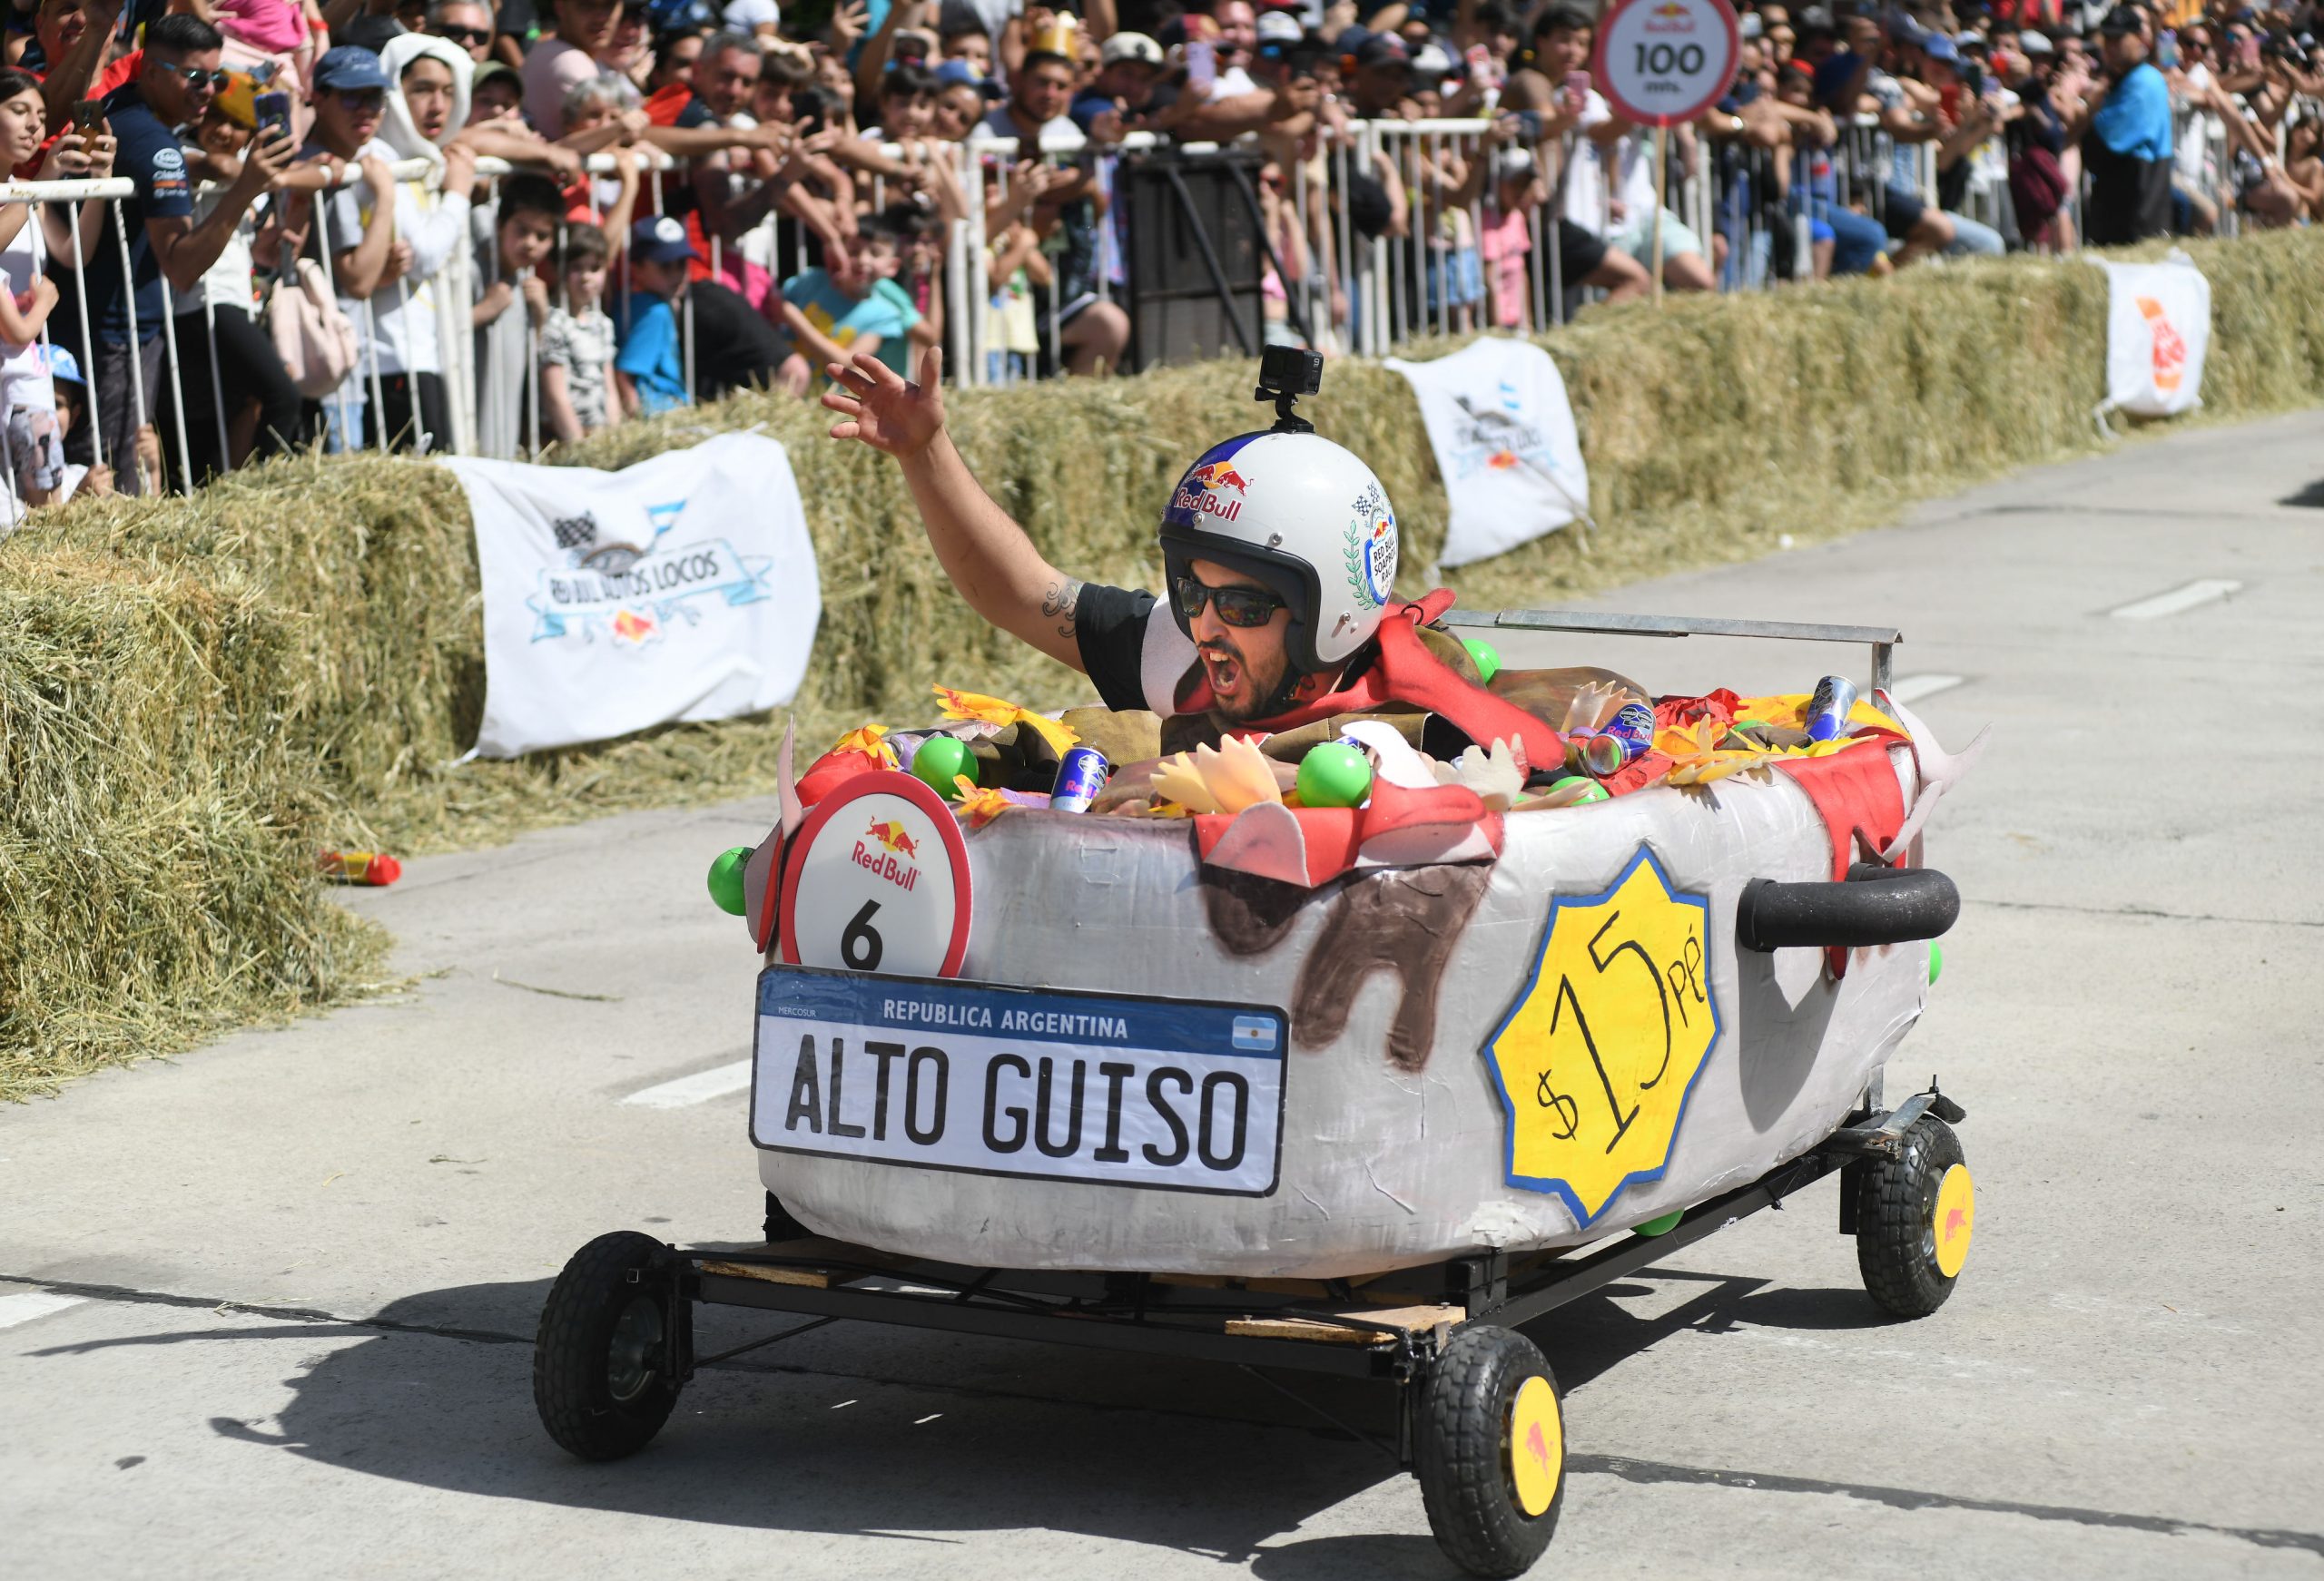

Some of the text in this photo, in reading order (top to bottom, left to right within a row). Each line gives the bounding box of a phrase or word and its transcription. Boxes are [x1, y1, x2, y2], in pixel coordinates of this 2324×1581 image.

[1635, 43, 1706, 75] 100
[1175, 487, 1242, 522] Red Bull
[654, 550, 720, 590] LOCOS
[1374, 545, 1385, 563] RED
[1607, 726, 1633, 740] Red
[852, 840, 918, 892] Red Bull
[841, 899, 883, 971] 6
[778, 1007, 817, 1017] MERCOSUR
[883, 999, 1128, 1039] REPUBLICA ARGENTINA
[784, 1034, 1250, 1172] ALTO GUISO
